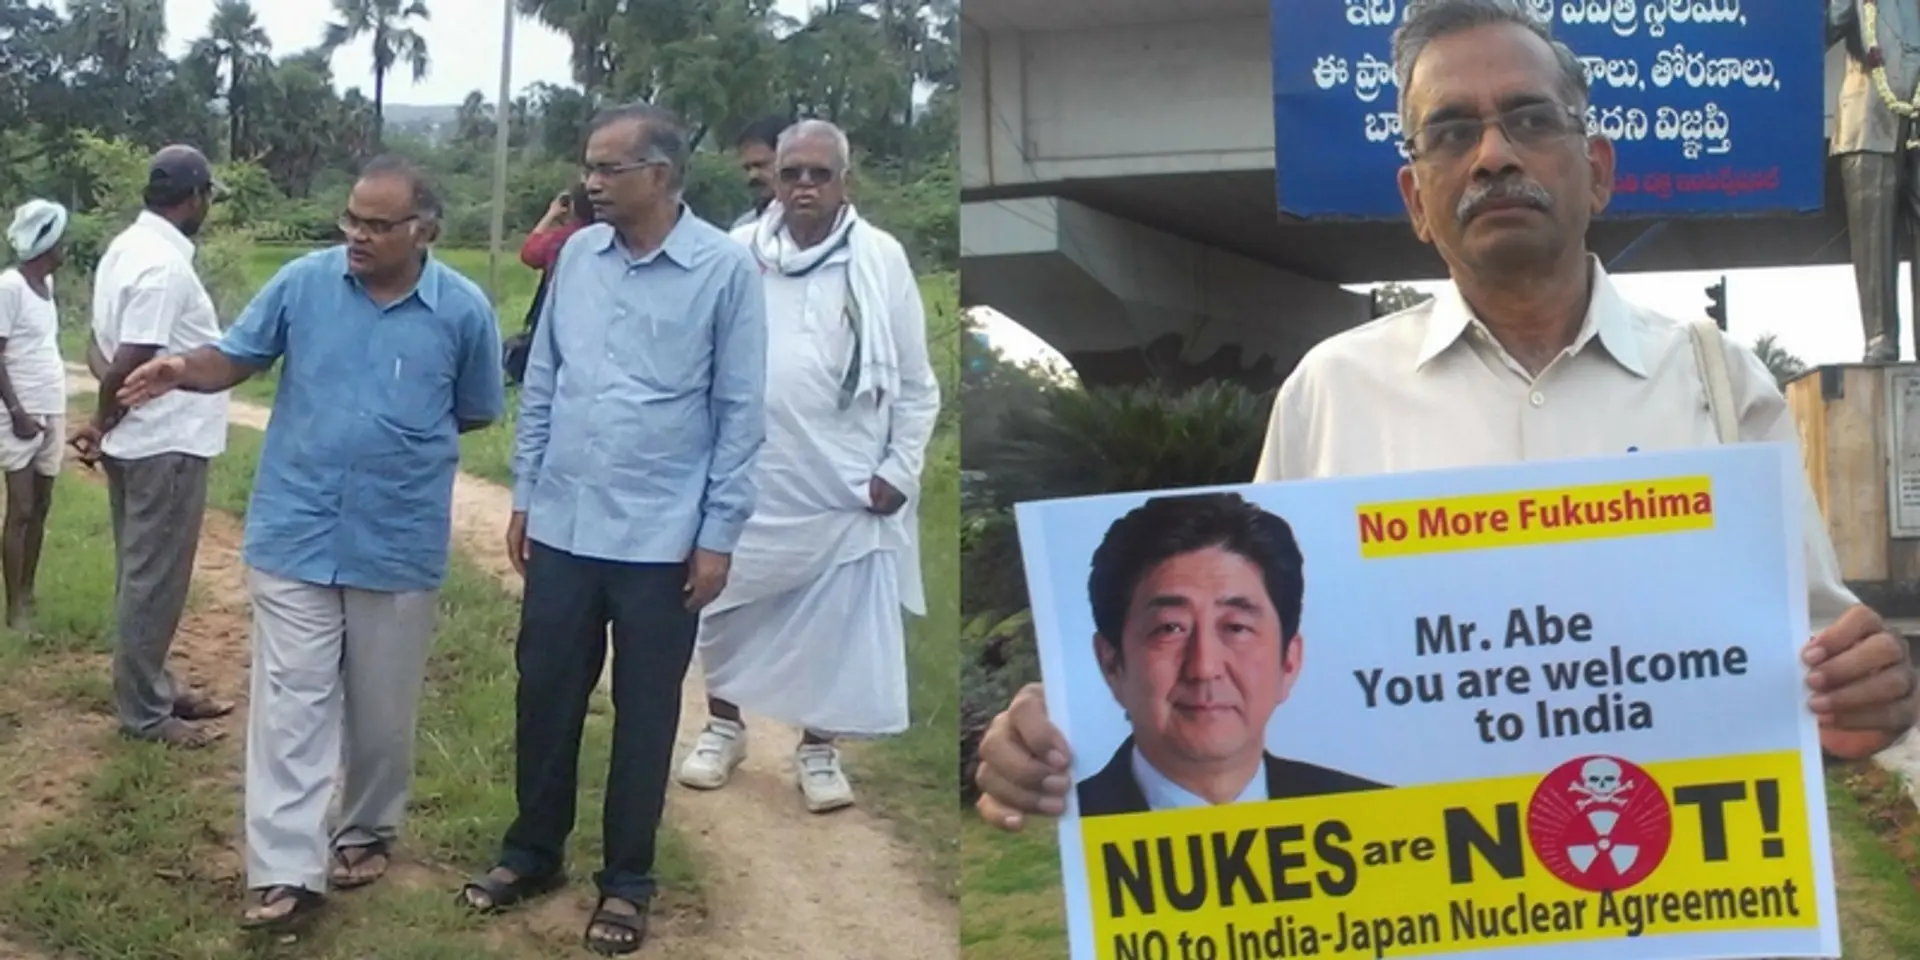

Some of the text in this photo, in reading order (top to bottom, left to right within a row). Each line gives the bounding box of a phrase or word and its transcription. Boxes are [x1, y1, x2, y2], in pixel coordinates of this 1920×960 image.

[1312, 54, 1350, 90] ఈ
[1359, 488, 1713, 544] No More Fukushima
[1415, 605, 1593, 656] Mr. Abe
[1354, 644, 1749, 708] You are welcome
[1475, 692, 1654, 744] to India
[1101, 819, 1357, 918] NUKES
[1363, 833, 1435, 867] are
[1113, 878, 1800, 960] NO to India-Japan Nuclear Agreement
